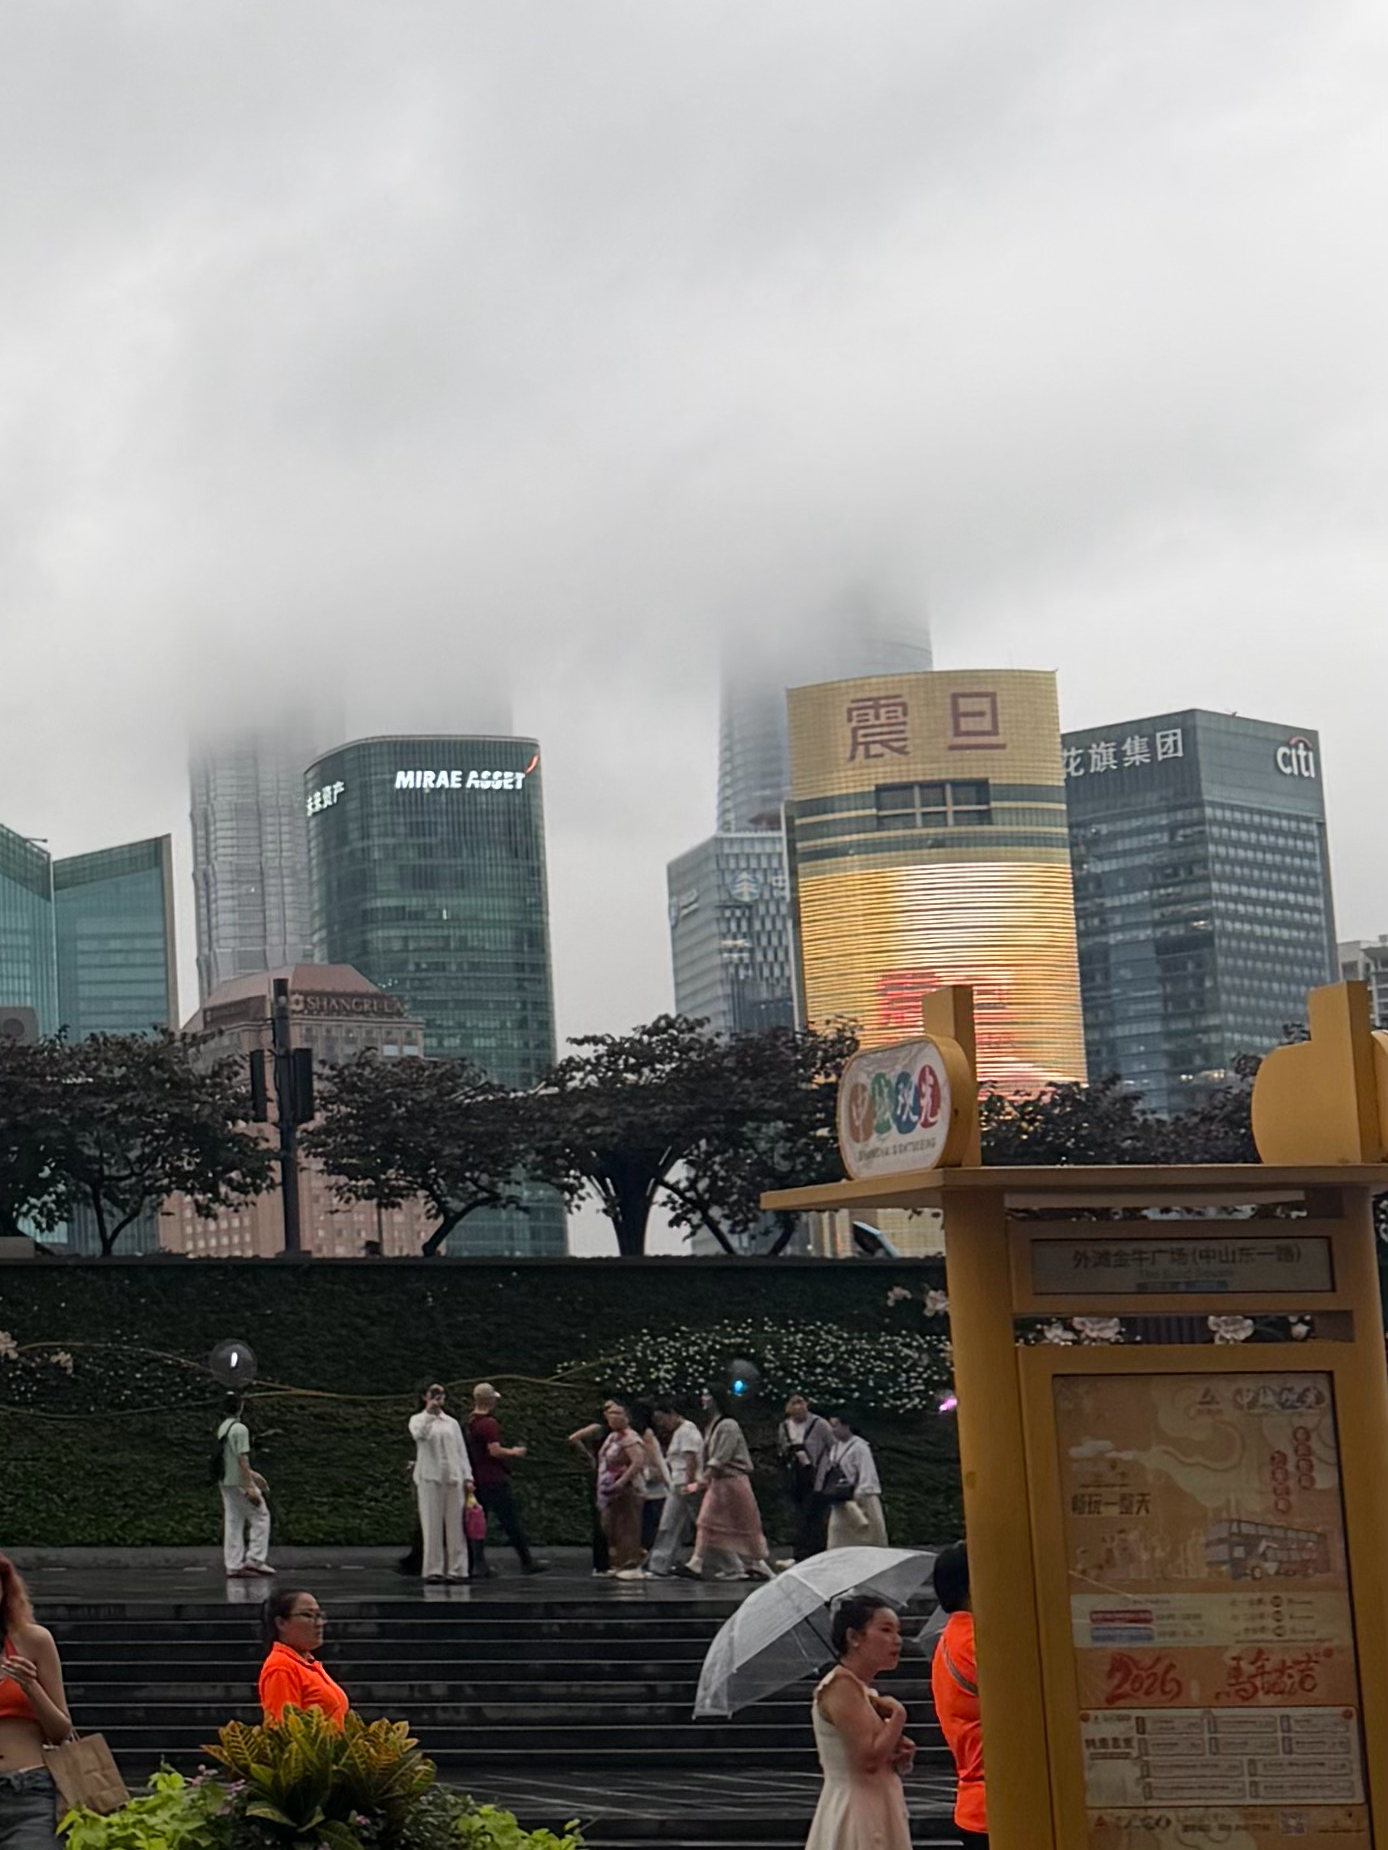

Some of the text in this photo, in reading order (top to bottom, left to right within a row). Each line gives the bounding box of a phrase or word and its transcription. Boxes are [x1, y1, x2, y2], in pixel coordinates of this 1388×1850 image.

[845, 691, 1006, 762] 震旦
[1062, 728, 1184, 778] 花旗集团
[1275, 740, 1317, 779] citi
[394, 770, 526, 790] MIRAE ASSET
[1105, 1652, 1183, 1706] 2026
